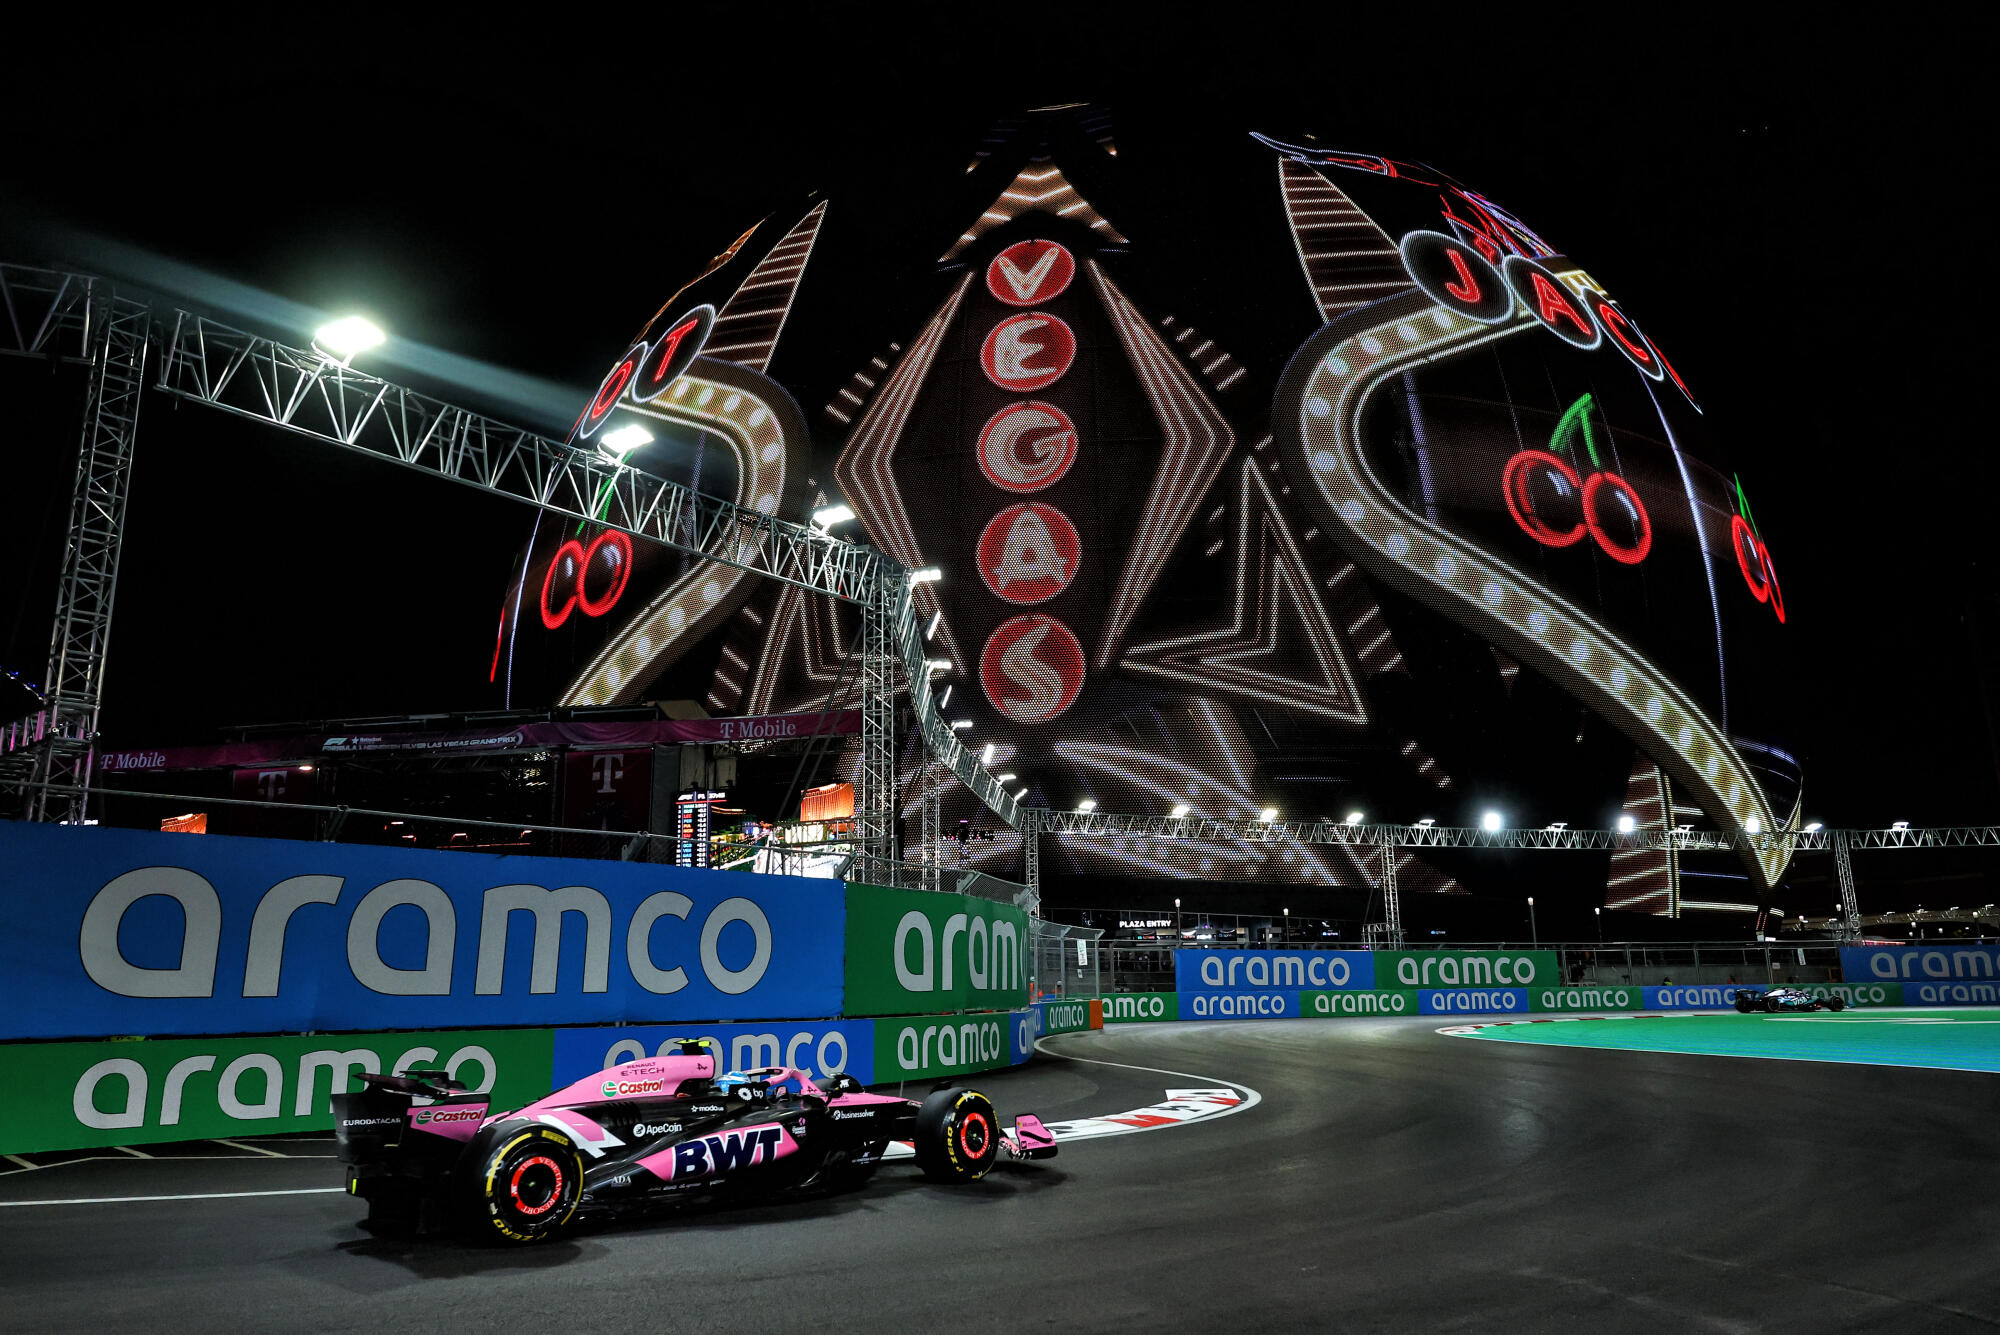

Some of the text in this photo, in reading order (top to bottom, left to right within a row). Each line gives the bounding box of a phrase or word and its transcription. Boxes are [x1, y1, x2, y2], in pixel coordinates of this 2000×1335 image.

[983, 245, 1075, 723] VEGAS
[738, 719, 796, 738] Mobile
[497, 735, 517, 744] PRIX
[115, 751, 167, 769] Mobile
[79, 865, 773, 999] aramco
[1119, 919, 1172, 928] PLAZA ENTRY
[893, 910, 1027, 992] aram
[1200, 955, 1351, 987] aramco
[1397, 955, 1536, 985] aramco
[1870, 951, 2000, 978] aram
[1314, 992, 1405, 1014] aramco
[1431, 991, 1517, 1011] aramco
[1541, 990, 1629, 1009] aramco
[1657, 987, 1736, 1007] aramc
[1919, 984, 2000, 1002] aram
[1102, 996, 1165, 1018] amco
[1193, 994, 1286, 1016] aramco
[1050, 1005, 1084, 1030] aramco
[897, 1021, 1000, 1070] aramco
[620, 1067, 665, 1077] E-TECH
[626, 1061, 656, 1069] RENAULT
[72, 1044, 498, 1130] aramco
[618, 1079, 664, 1095] Castrol
[432, 1109, 483, 1124] Castrol
[840, 1108, 876, 1119] businessolver
[646, 1123, 683, 1136] ApeCoin
[671, 1124, 784, 1181] BWT
[539, 1156, 563, 1195] VENETIAN
[520, 1197, 556, 1215] RESORT
